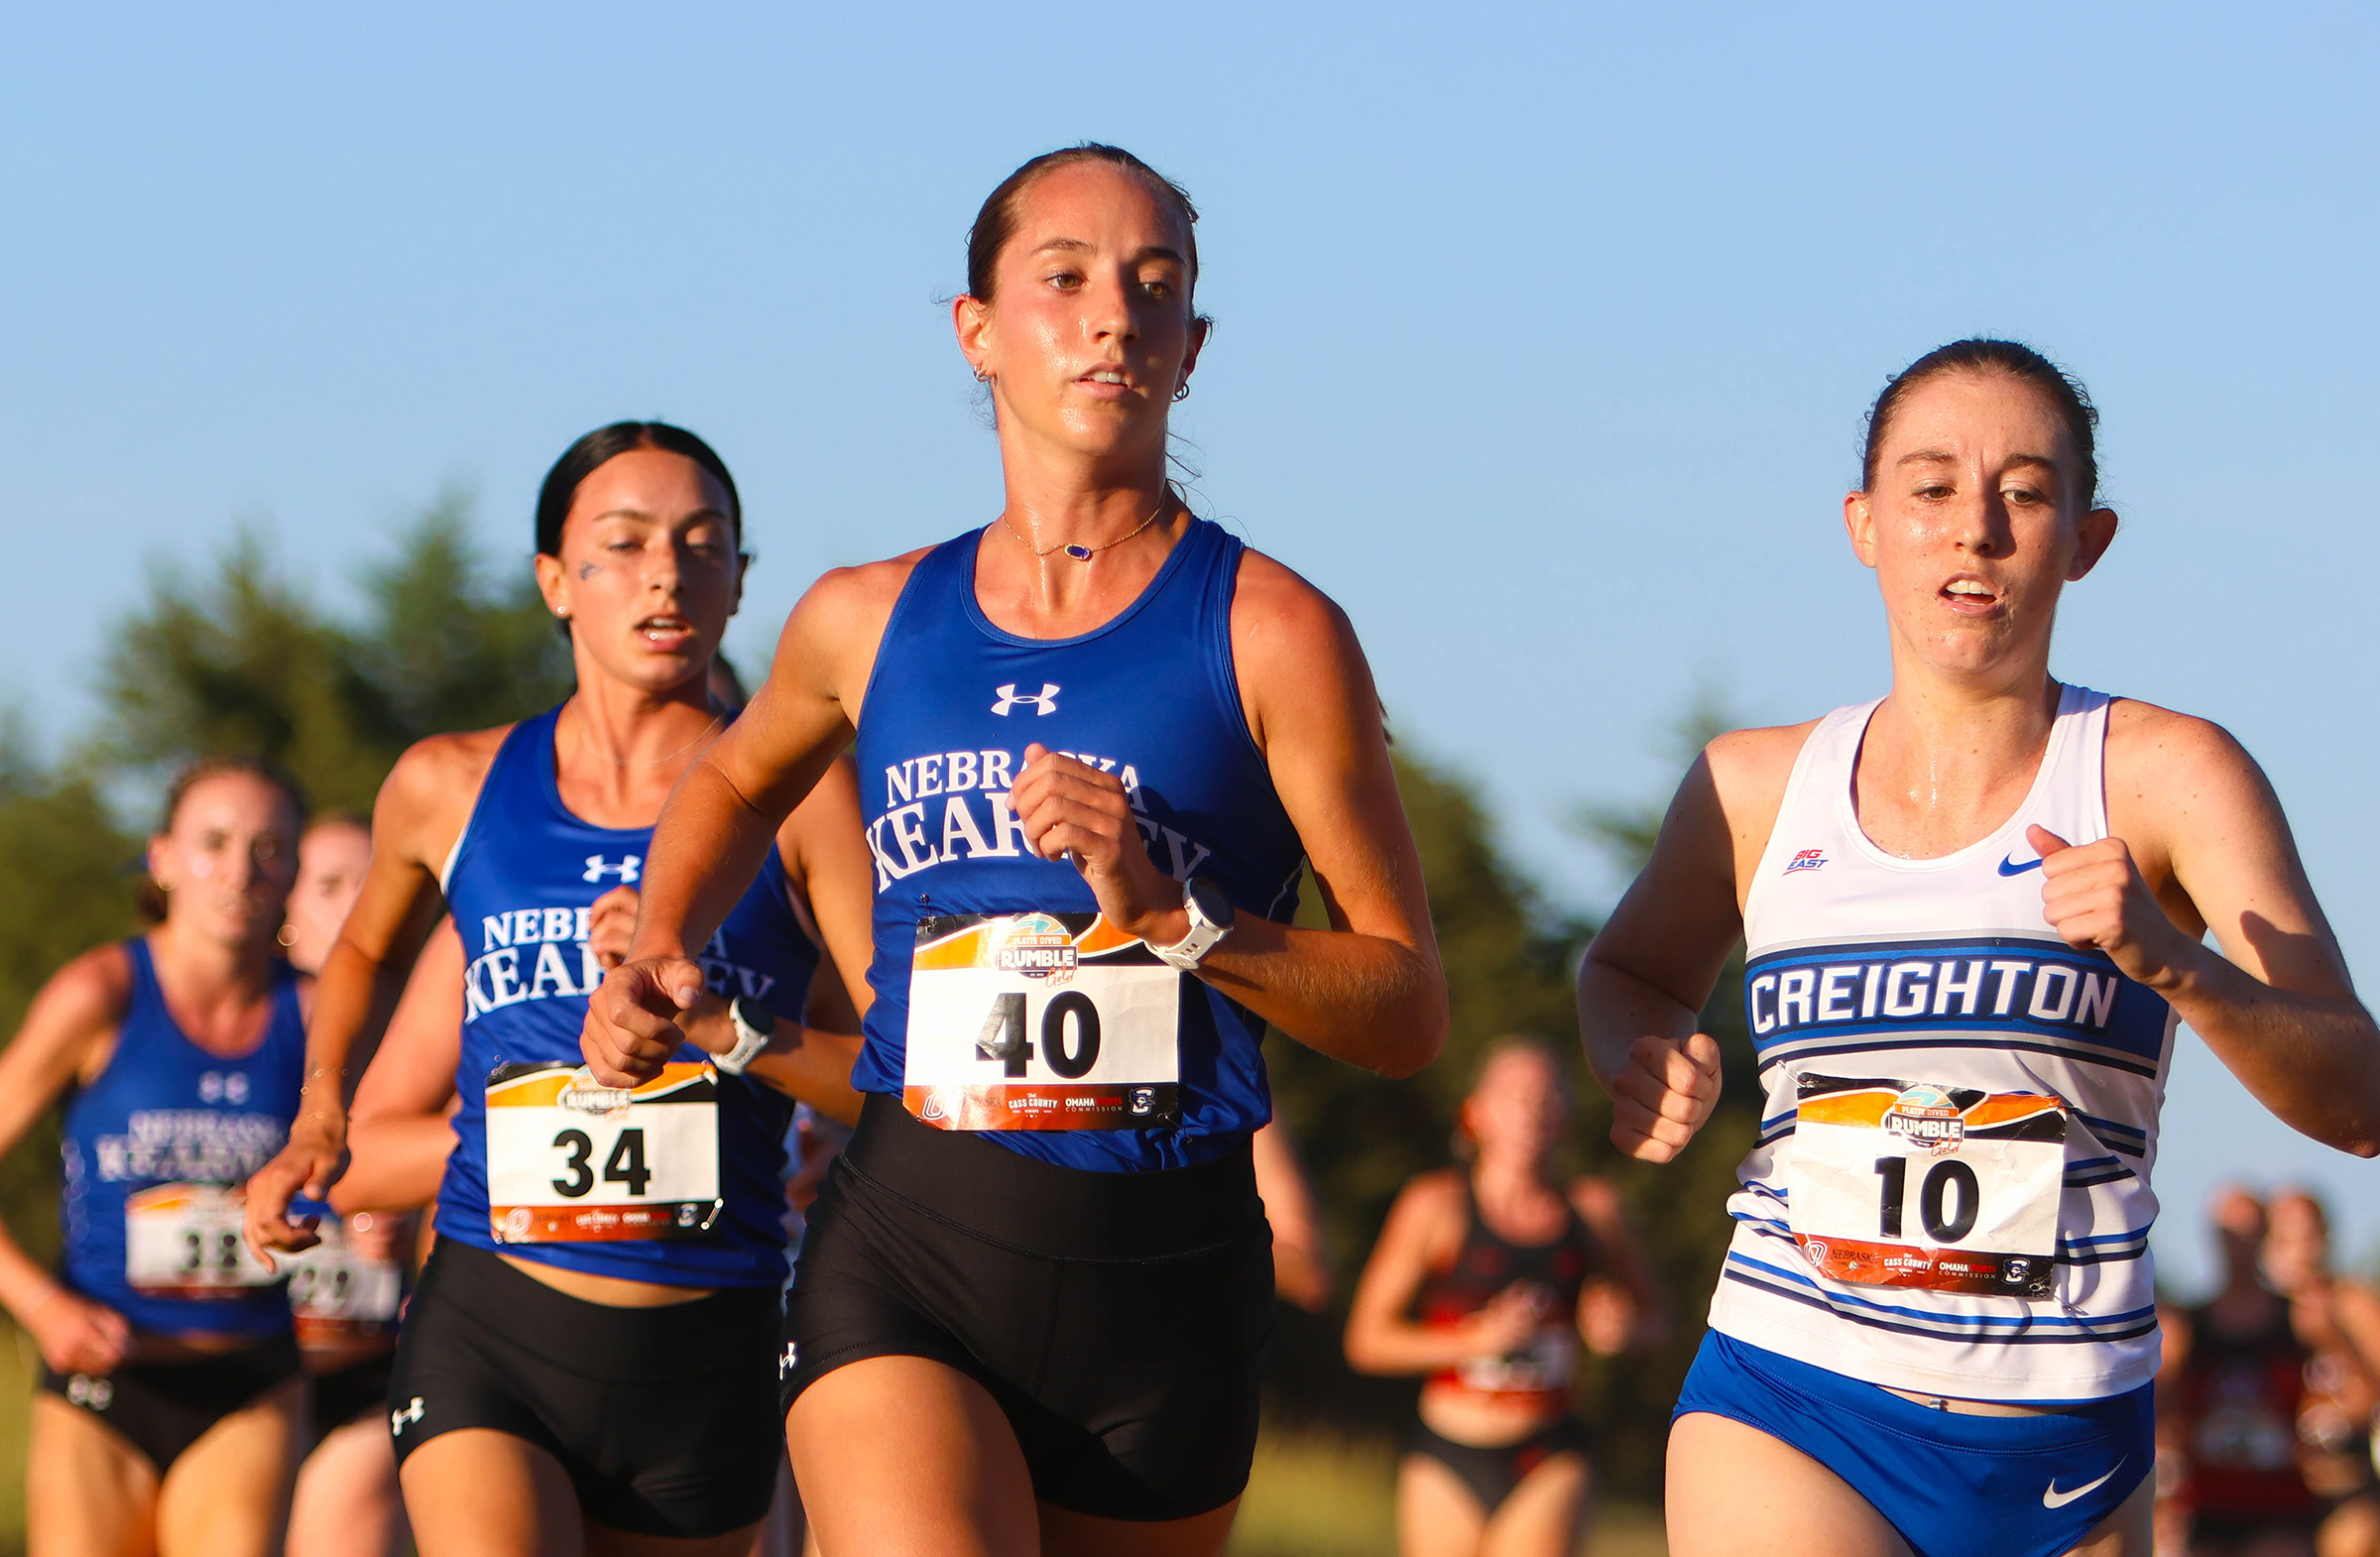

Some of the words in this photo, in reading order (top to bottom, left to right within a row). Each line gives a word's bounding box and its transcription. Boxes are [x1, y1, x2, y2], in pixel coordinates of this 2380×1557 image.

[886, 750, 1148, 813] NEBRA
[865, 792, 1211, 895] KEARY
[1786, 859, 1830, 871] EAST
[1793, 849, 1824, 861] BIG
[1001, 949, 1075, 967] RUMBLE
[1046, 962, 1076, 988] Gold
[1750, 961, 2118, 1034] CREIGHTON
[975, 992, 1101, 1079] 40
[1009, 1099, 1027, 1109] CASS
[1028, 1098, 1058, 1109] COUNTY
[1065, 1098, 1095, 1107] OMAHA
[1891, 1116, 1962, 1138] RUMBLE
[552, 1129, 651, 1197] 34
[1874, 1156, 1979, 1244] 10
[1883, 1258, 1902, 1266] CASS
[1903, 1258, 1932, 1270] COUNTY
[1939, 1261, 1968, 1272] OMAHA
[1939, 1270, 1995, 1279] COMMISSION
